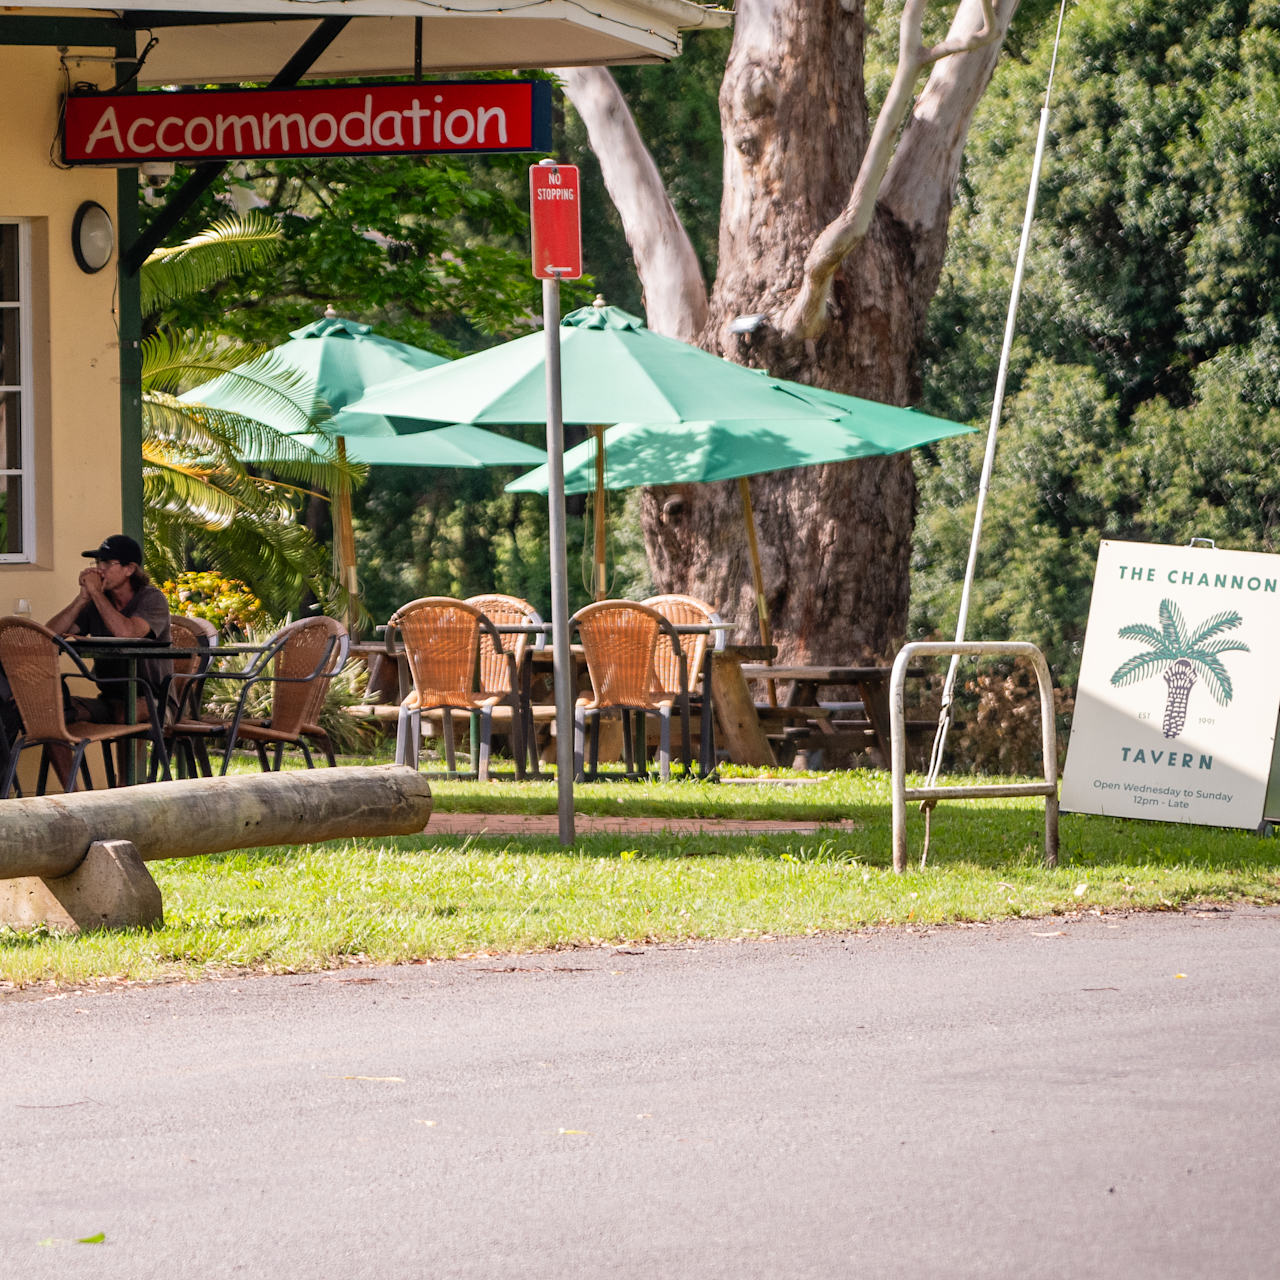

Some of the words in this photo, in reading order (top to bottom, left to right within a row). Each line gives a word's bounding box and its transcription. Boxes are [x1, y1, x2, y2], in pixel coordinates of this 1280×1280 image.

[84, 94, 507, 155] Accommodation
[548, 173, 561, 185] NO
[537, 188, 574, 200] STOPPING
[1119, 565, 1155, 582] THE
[1167, 570, 1277, 593] CHANNON
[1121, 747, 1213, 770] TAVERN
[1093, 779, 1121, 791] Open
[1123, 783, 1181, 798] Wednesday
[1183, 789, 1194, 798] to
[1196, 790, 1233, 803] Sunday
[1133, 795, 1159, 807] 12pm
[1168, 799, 1190, 809] Late
